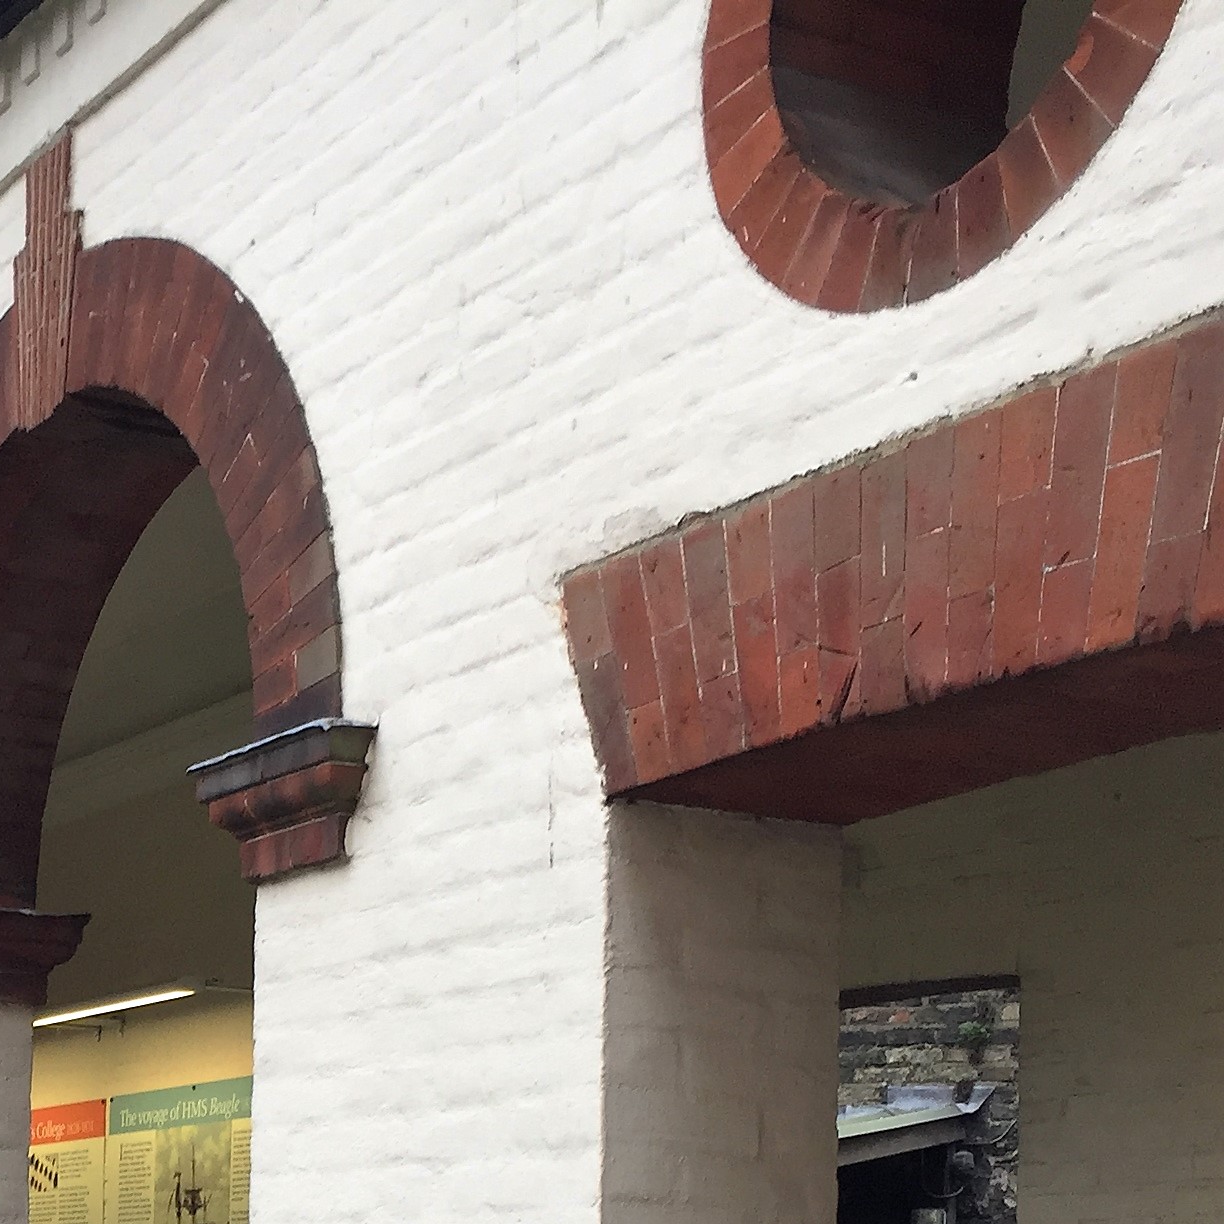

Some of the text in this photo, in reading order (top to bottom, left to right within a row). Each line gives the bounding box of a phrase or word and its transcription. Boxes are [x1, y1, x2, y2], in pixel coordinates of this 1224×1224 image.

[120, 1108, 137, 1127] The
[138, 1108, 168, 1128] voyage
[169, 1101, 182, 1121] of
[182, 1098, 207, 1119] HMS
[209, 1093, 240, 1119] Beagle
[36, 1120, 65, 1141] College
